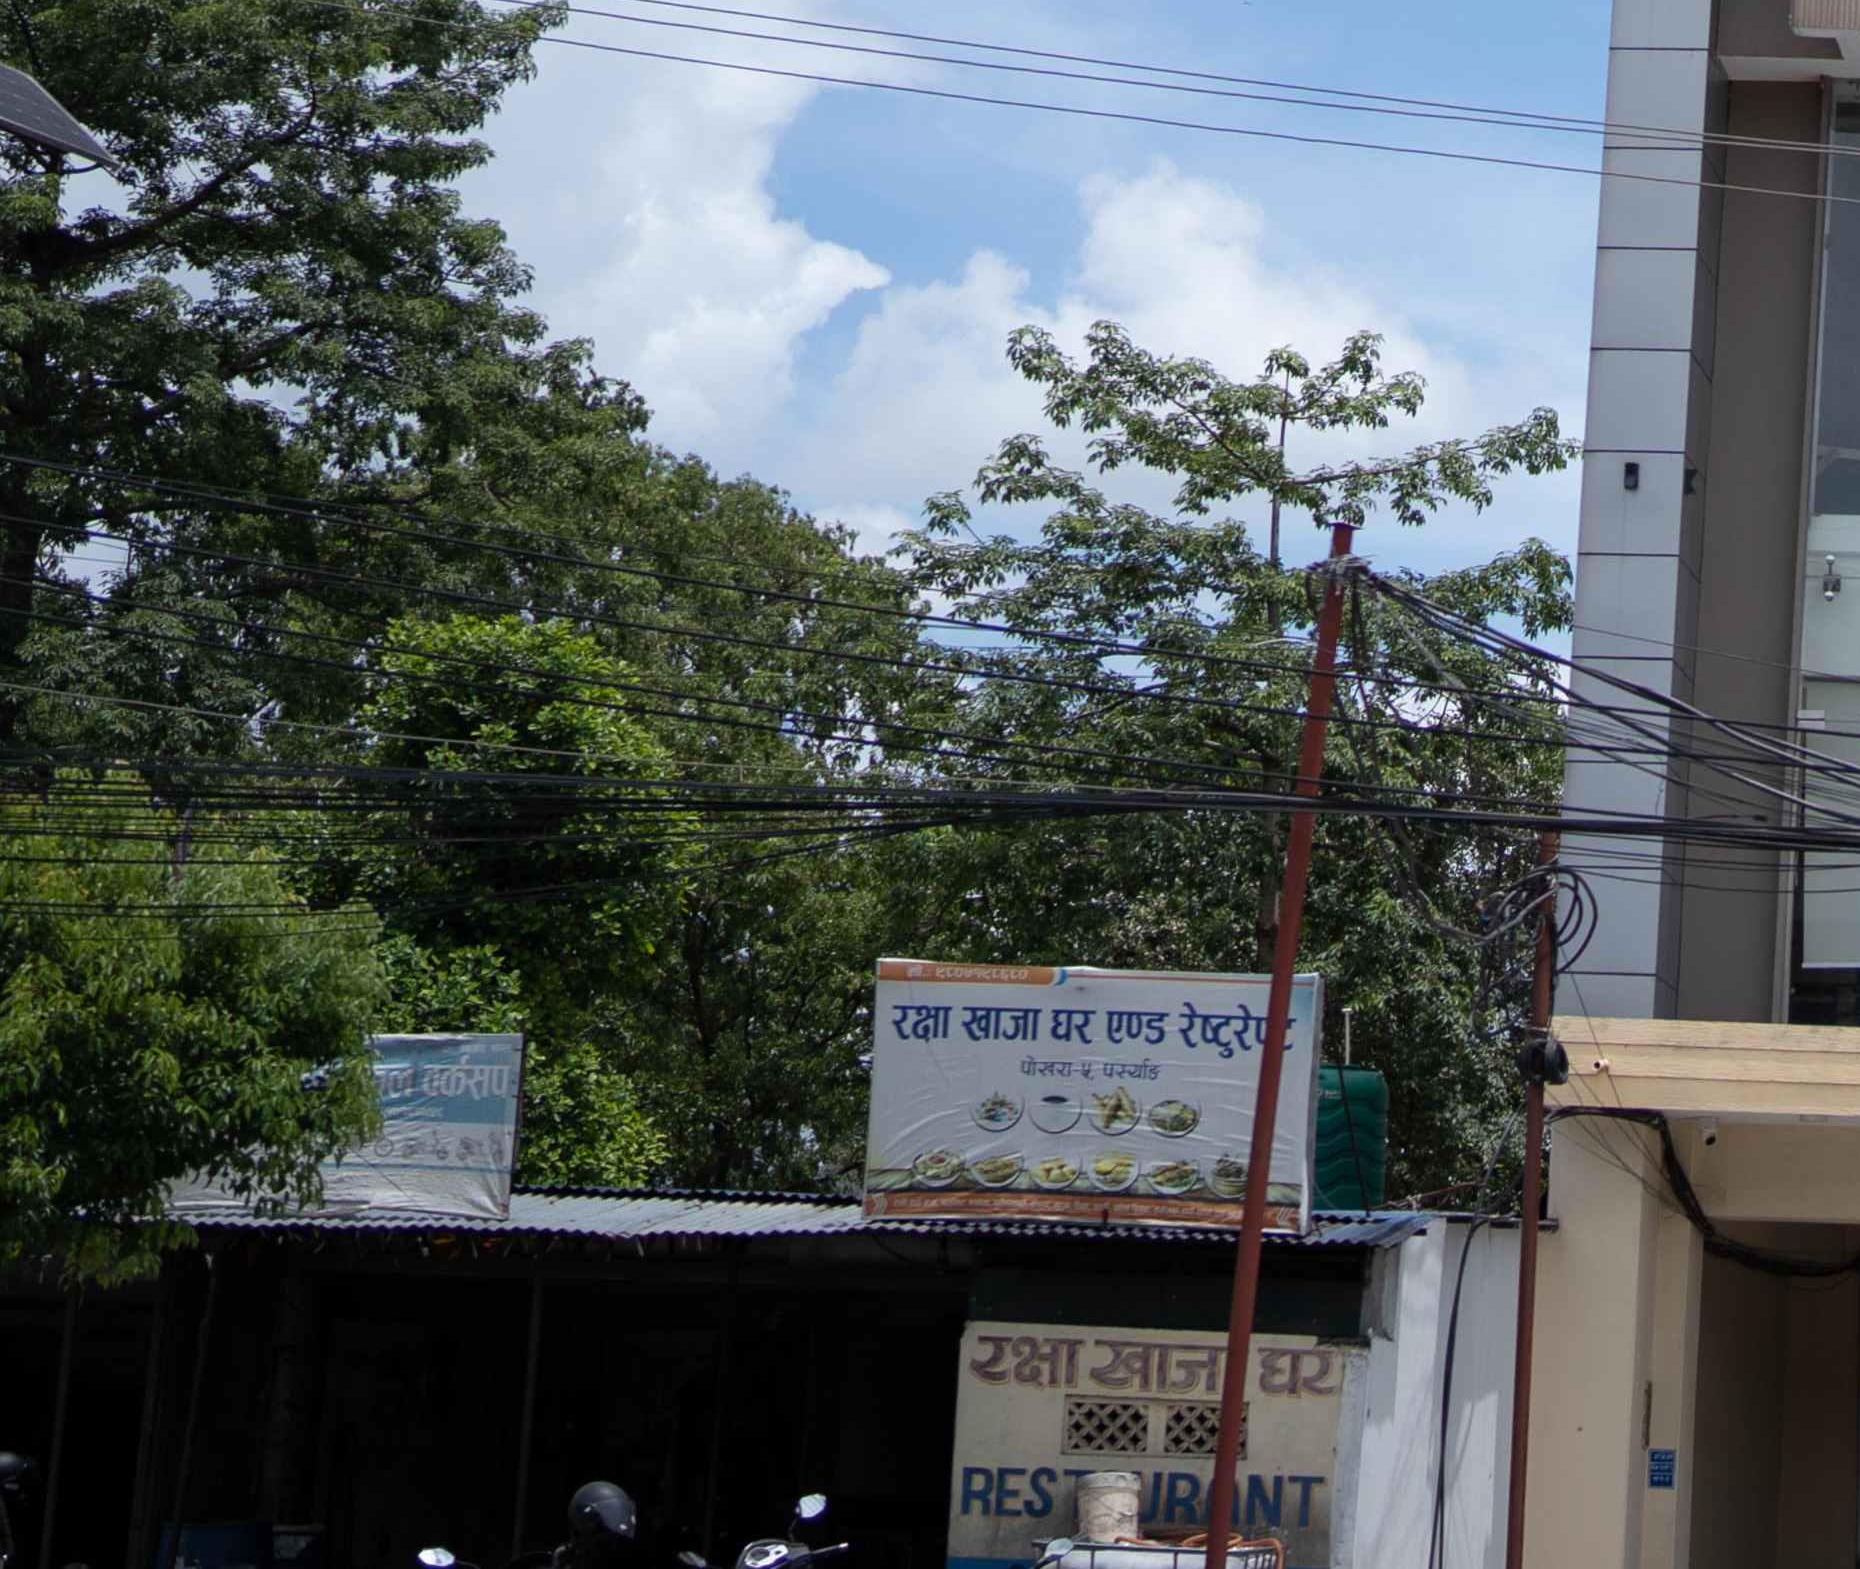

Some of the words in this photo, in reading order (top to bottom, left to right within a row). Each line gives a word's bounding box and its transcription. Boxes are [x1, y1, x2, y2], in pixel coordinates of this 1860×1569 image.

[892, 1004, 952, 1043] रक्षा
[962, 1005, 1042, 1041] खाजा
[1049, 1008, 1097, 1045] घर
[1105, 1010, 1168, 1045] एण्ड
[969, 1334, 1085, 1390] रक्षा
[1257, 1346, 1338, 1398] घर
